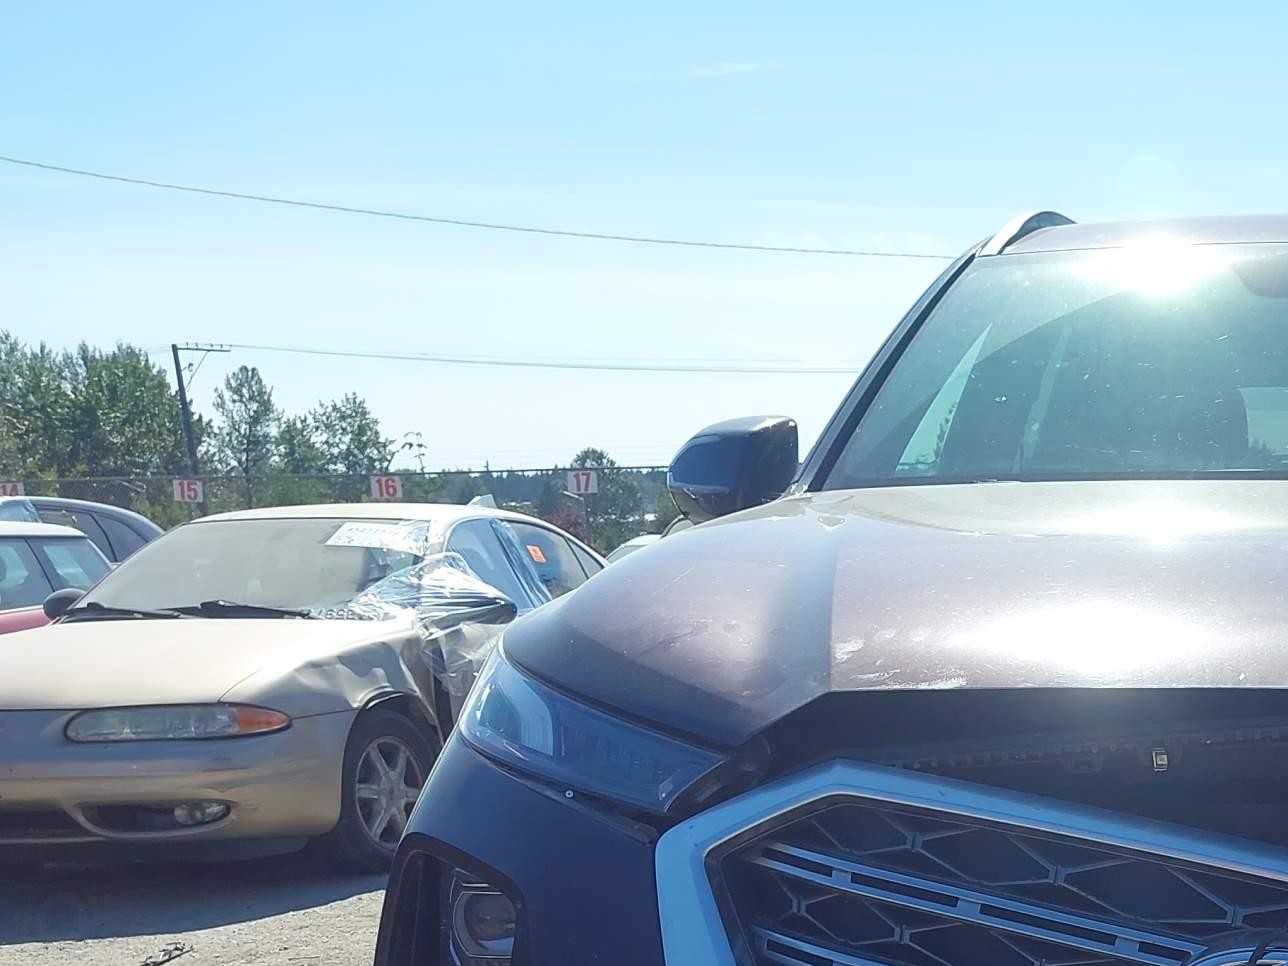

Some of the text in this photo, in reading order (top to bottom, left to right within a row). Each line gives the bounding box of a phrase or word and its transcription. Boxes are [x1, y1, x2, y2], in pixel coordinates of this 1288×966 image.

[178, 482, 198, 501] 15
[375, 478, 397, 497] 16
[573, 472, 592, 492] 17
